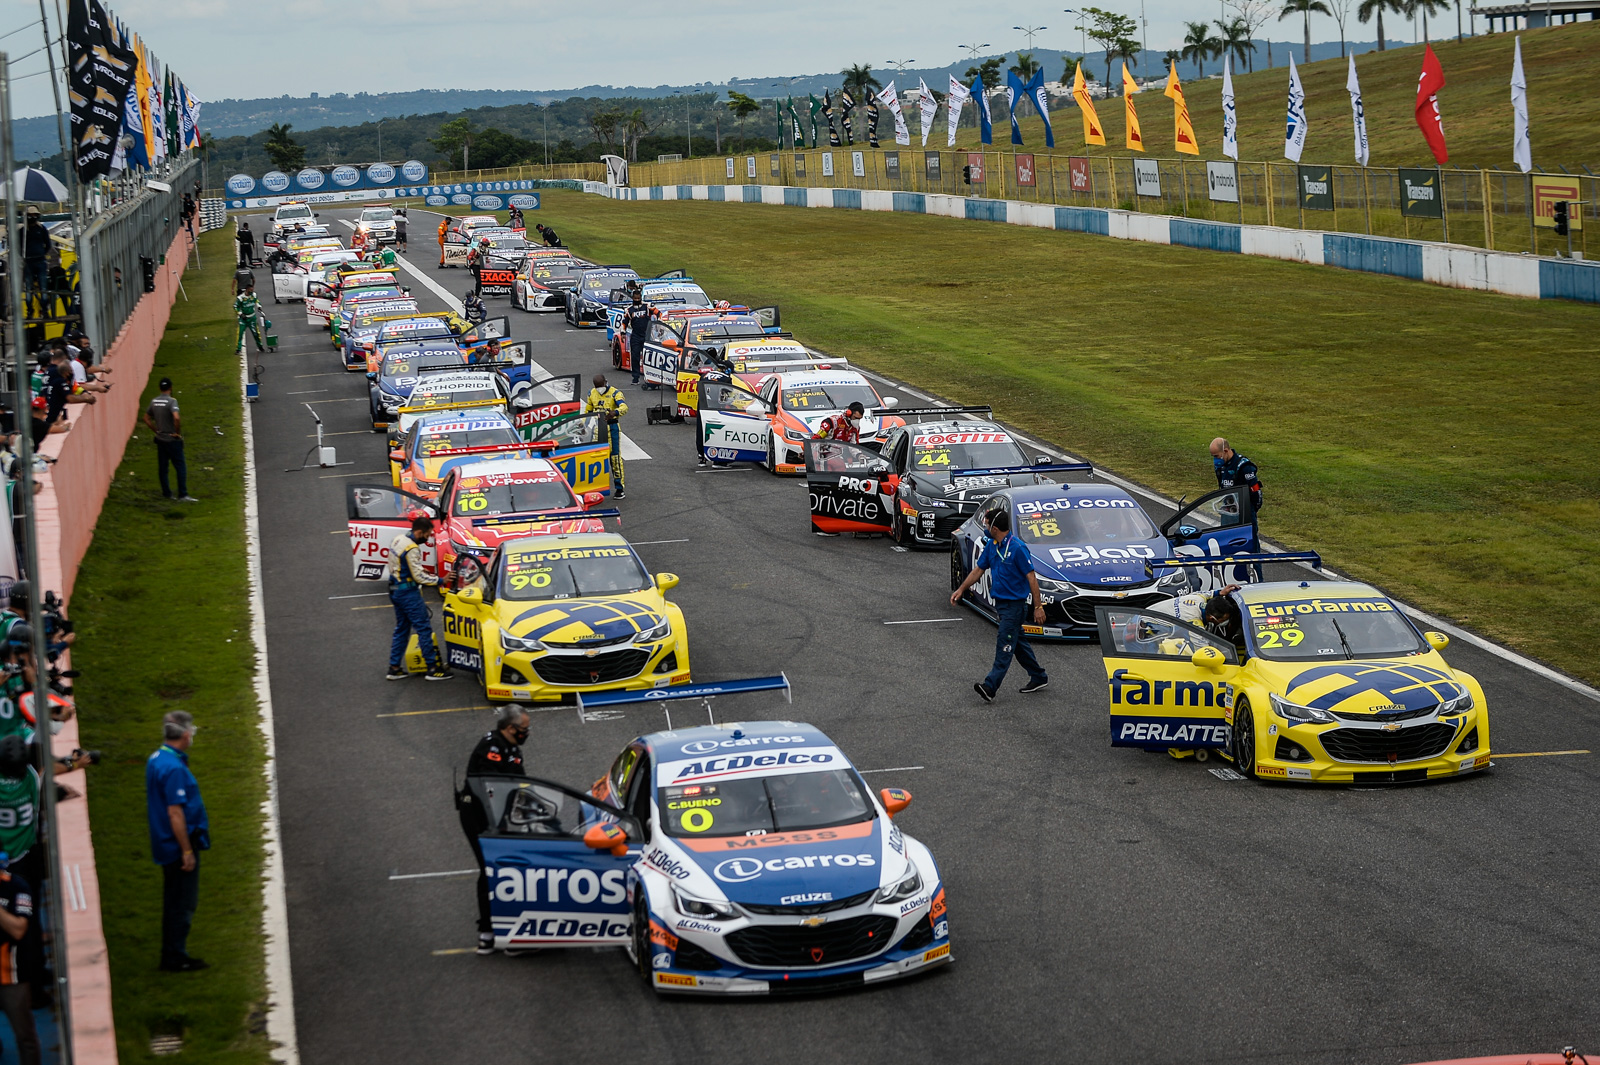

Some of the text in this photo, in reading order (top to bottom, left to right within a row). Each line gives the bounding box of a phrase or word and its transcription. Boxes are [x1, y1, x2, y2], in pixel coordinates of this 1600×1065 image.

[1072, 168, 1086, 187] Claro
[1141, 170, 1158, 183] motorola
[1215, 174, 1234, 187] motorola
[1535, 185, 1578, 220] PIRLI
[480, 273, 514, 282] EXACO
[355, 290, 390, 298] JEFER
[749, 345, 798, 353] RAUMAK
[389, 364, 410, 374] 70
[416, 383, 492, 393] ORTHOPRIDE
[789, 397, 809, 407] 11
[725, 430, 767, 445] FATOR
[914, 433, 1007, 446] LOCTITE
[917, 453, 951, 467] 44
[486, 475, 554, 487] V-Power
[457, 497, 488, 512] 10
[1028, 522, 1061, 538] 18
[507, 547, 631, 566] Eurofarma
[1056, 557, 1144, 570] FARMACÊUTI
[510, 573, 552, 591] 90
[1248, 599, 1393, 618] Eurofarma
[1258, 622, 1300, 630] D.SERRA
[1256, 629, 1305, 649] 29
[1368, 704, 1406, 712] CRUZE
[1120, 722, 1226, 742] PERLATTE
[718, 735, 806, 748] carros
[677, 752, 833, 778] ACDelco
[1257, 766, 1285, 775] PIRELLI
[667, 798, 722, 810] C.BUENO
[680, 808, 714, 832] 0
[647, 847, 690, 880] ACDelco
[764, 853, 876, 872] carros
[780, 892, 833, 905] CRUZE
[900, 896, 930, 914] ACDelco
[677, 919, 722, 934] ACDelco
[924, 944, 949, 962] PIRELLI
[658, 974, 696, 986] PIRELLI
